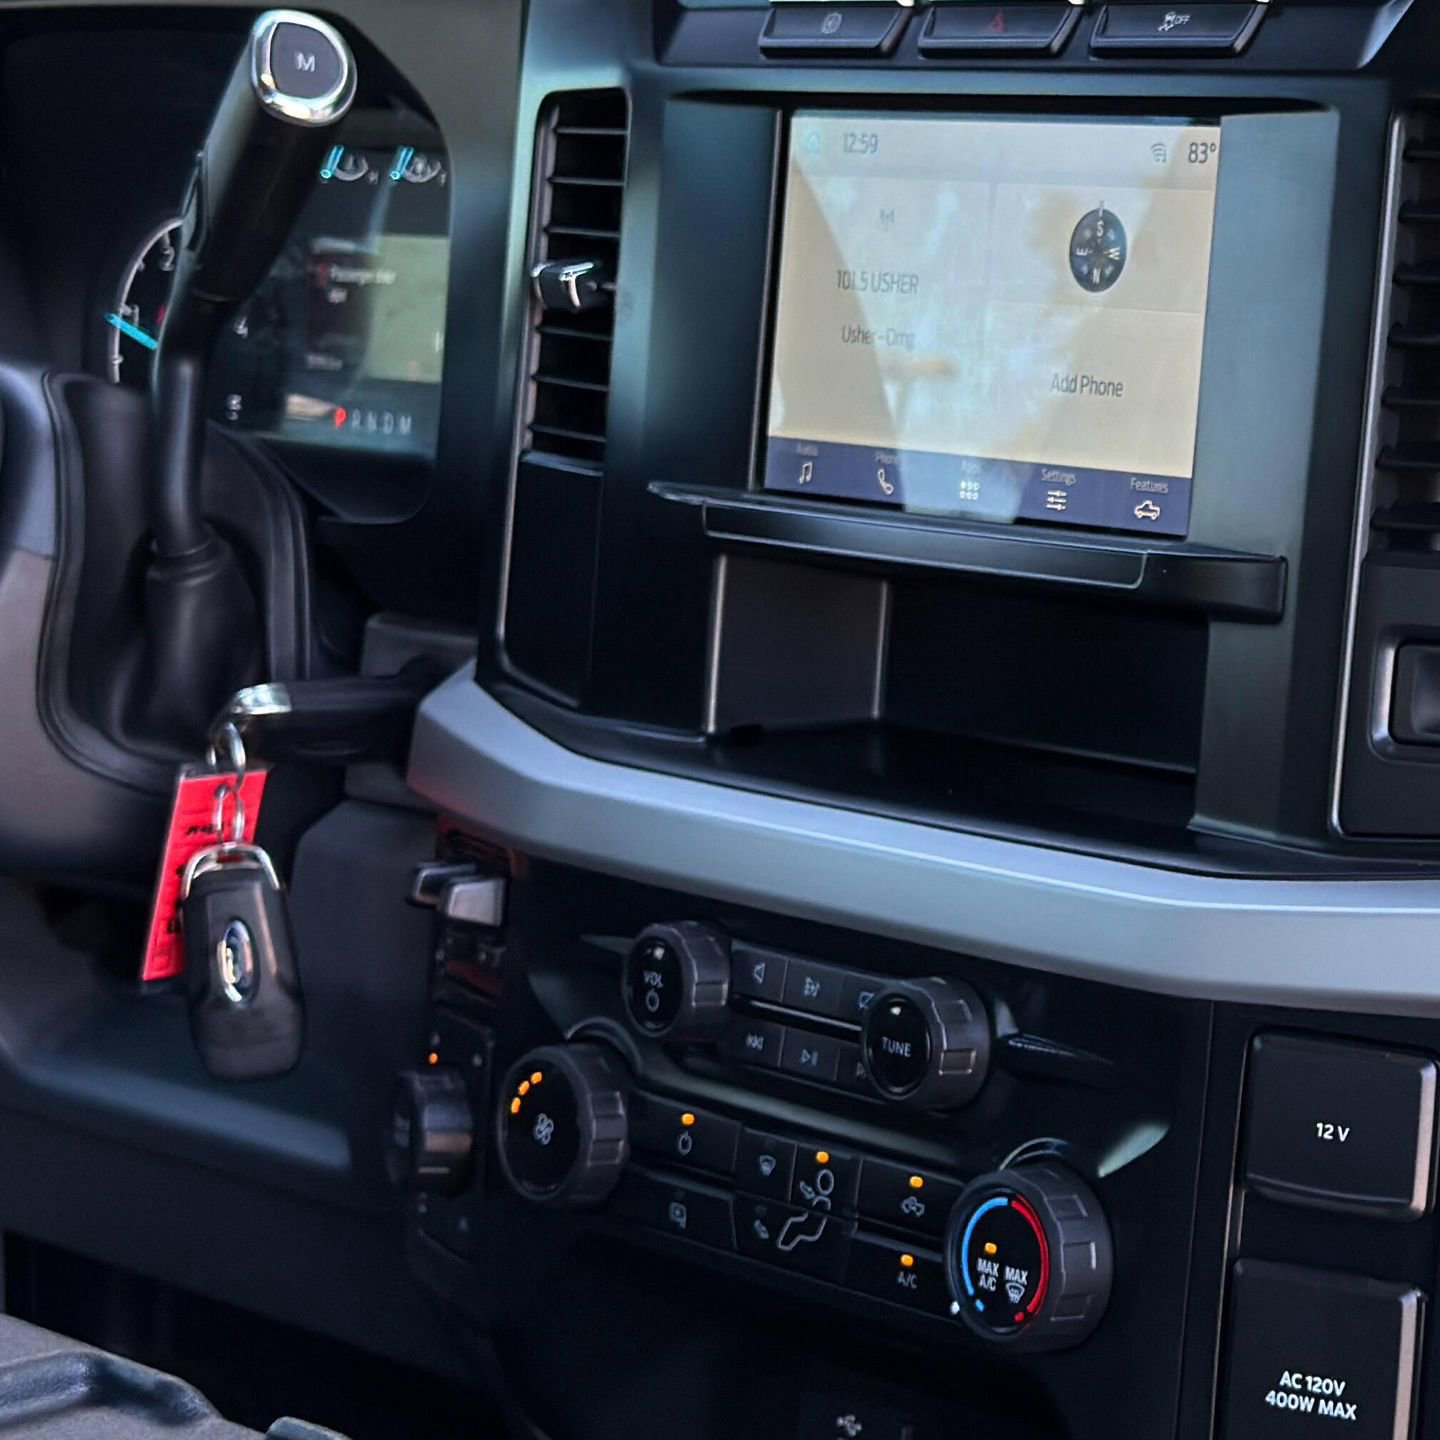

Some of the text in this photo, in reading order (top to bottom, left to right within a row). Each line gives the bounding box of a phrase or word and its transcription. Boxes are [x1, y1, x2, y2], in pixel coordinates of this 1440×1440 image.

[842, 133, 879, 154] 12:59
[870, 271, 919, 295] USHER
[1050, 373, 1124, 398] Add Phone
[1041, 468, 1077, 486] Settings
[1130, 477, 1170, 494] Features
[643, 970, 664, 989] VOL
[881, 1036, 912, 1058] TUNE
[1316, 1122, 1351, 1143] 12 V
[976, 1257, 1000, 1278] MAX
[1005, 1265, 1029, 1286] MAX
[897, 1270, 918, 1289] A/C
[979, 1273, 997, 1292] A/C
[1279, 1370, 1346, 1397] AC 120V
[1265, 1390, 1358, 1421] 400W MAX
